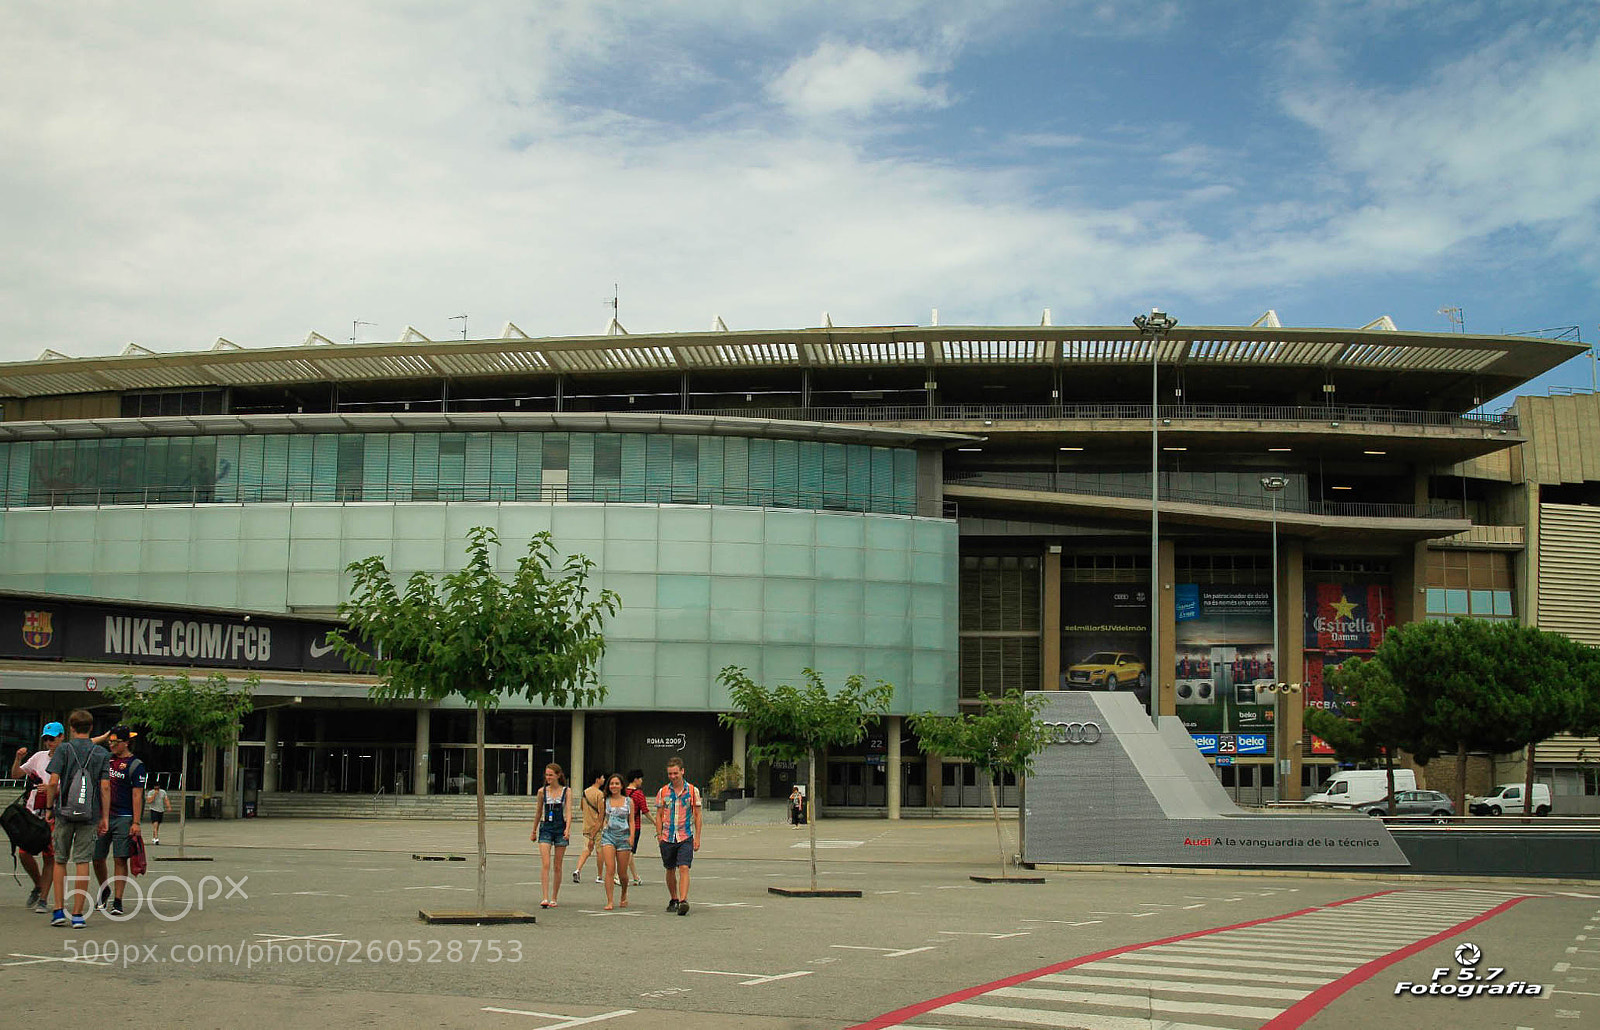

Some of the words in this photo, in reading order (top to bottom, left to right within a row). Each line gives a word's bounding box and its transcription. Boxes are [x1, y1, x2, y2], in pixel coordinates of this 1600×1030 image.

[1313, 616, 1376, 632] Estrella
[105, 616, 271, 661] NIKE.COM/FCB
[1331, 632, 1358, 642] Damm
[1239, 711, 1257, 719] beko
[646, 737, 664, 745] ROMA
[665, 737, 682, 745] 2009
[870, 739, 883, 748] 22
[1238, 736, 1265, 746] beko
[1219, 741, 1235, 752] 25
[1183, 837, 1211, 847] Audi
[1214, 837, 1223, 847] A
[1225, 837, 1237, 847] la
[1239, 837, 1304, 849] vanguardia
[1307, 837, 1322, 847] de
[1324, 837, 1335, 847] la
[1338, 837, 1380, 847] técnica
